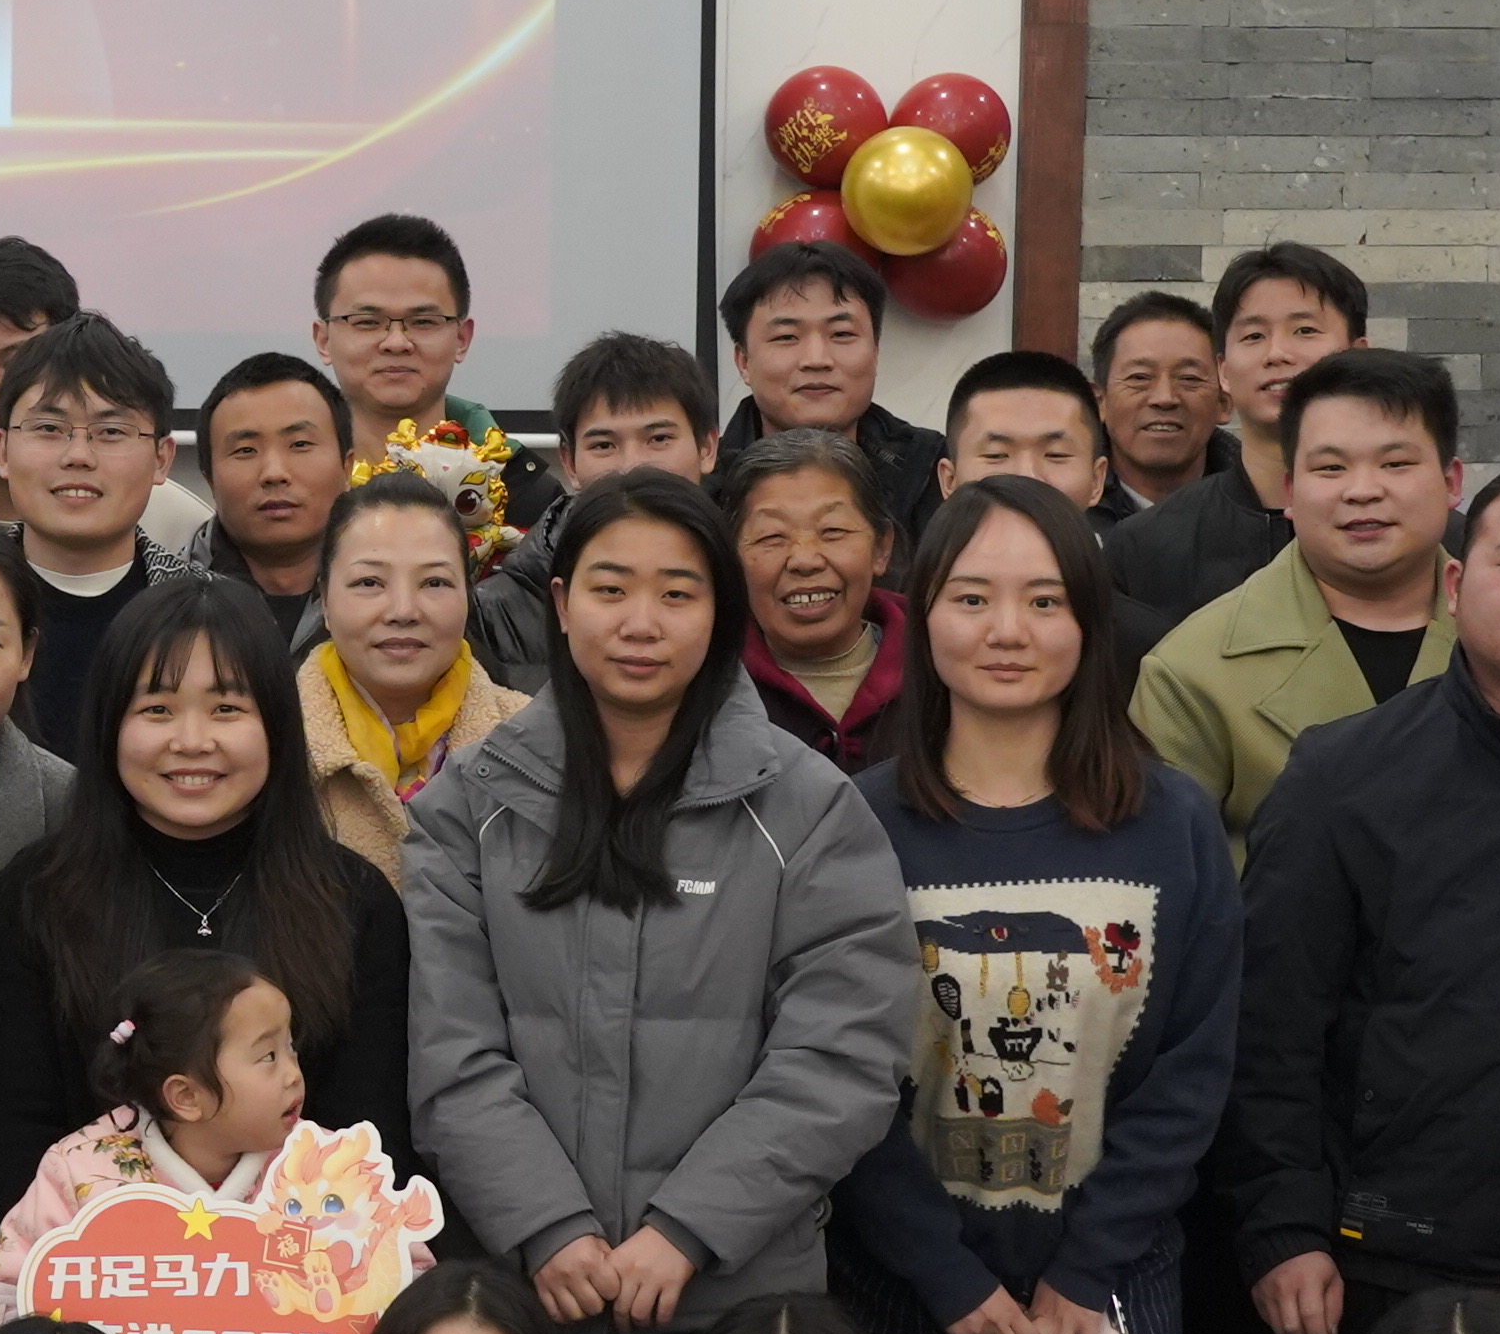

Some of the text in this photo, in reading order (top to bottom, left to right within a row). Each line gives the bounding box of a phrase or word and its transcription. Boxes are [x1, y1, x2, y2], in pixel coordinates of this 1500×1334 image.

[676, 879, 716, 895] FCMM
[277, 1233, 300, 1259] 福
[47, 1252, 250, 1300] 开足马力
